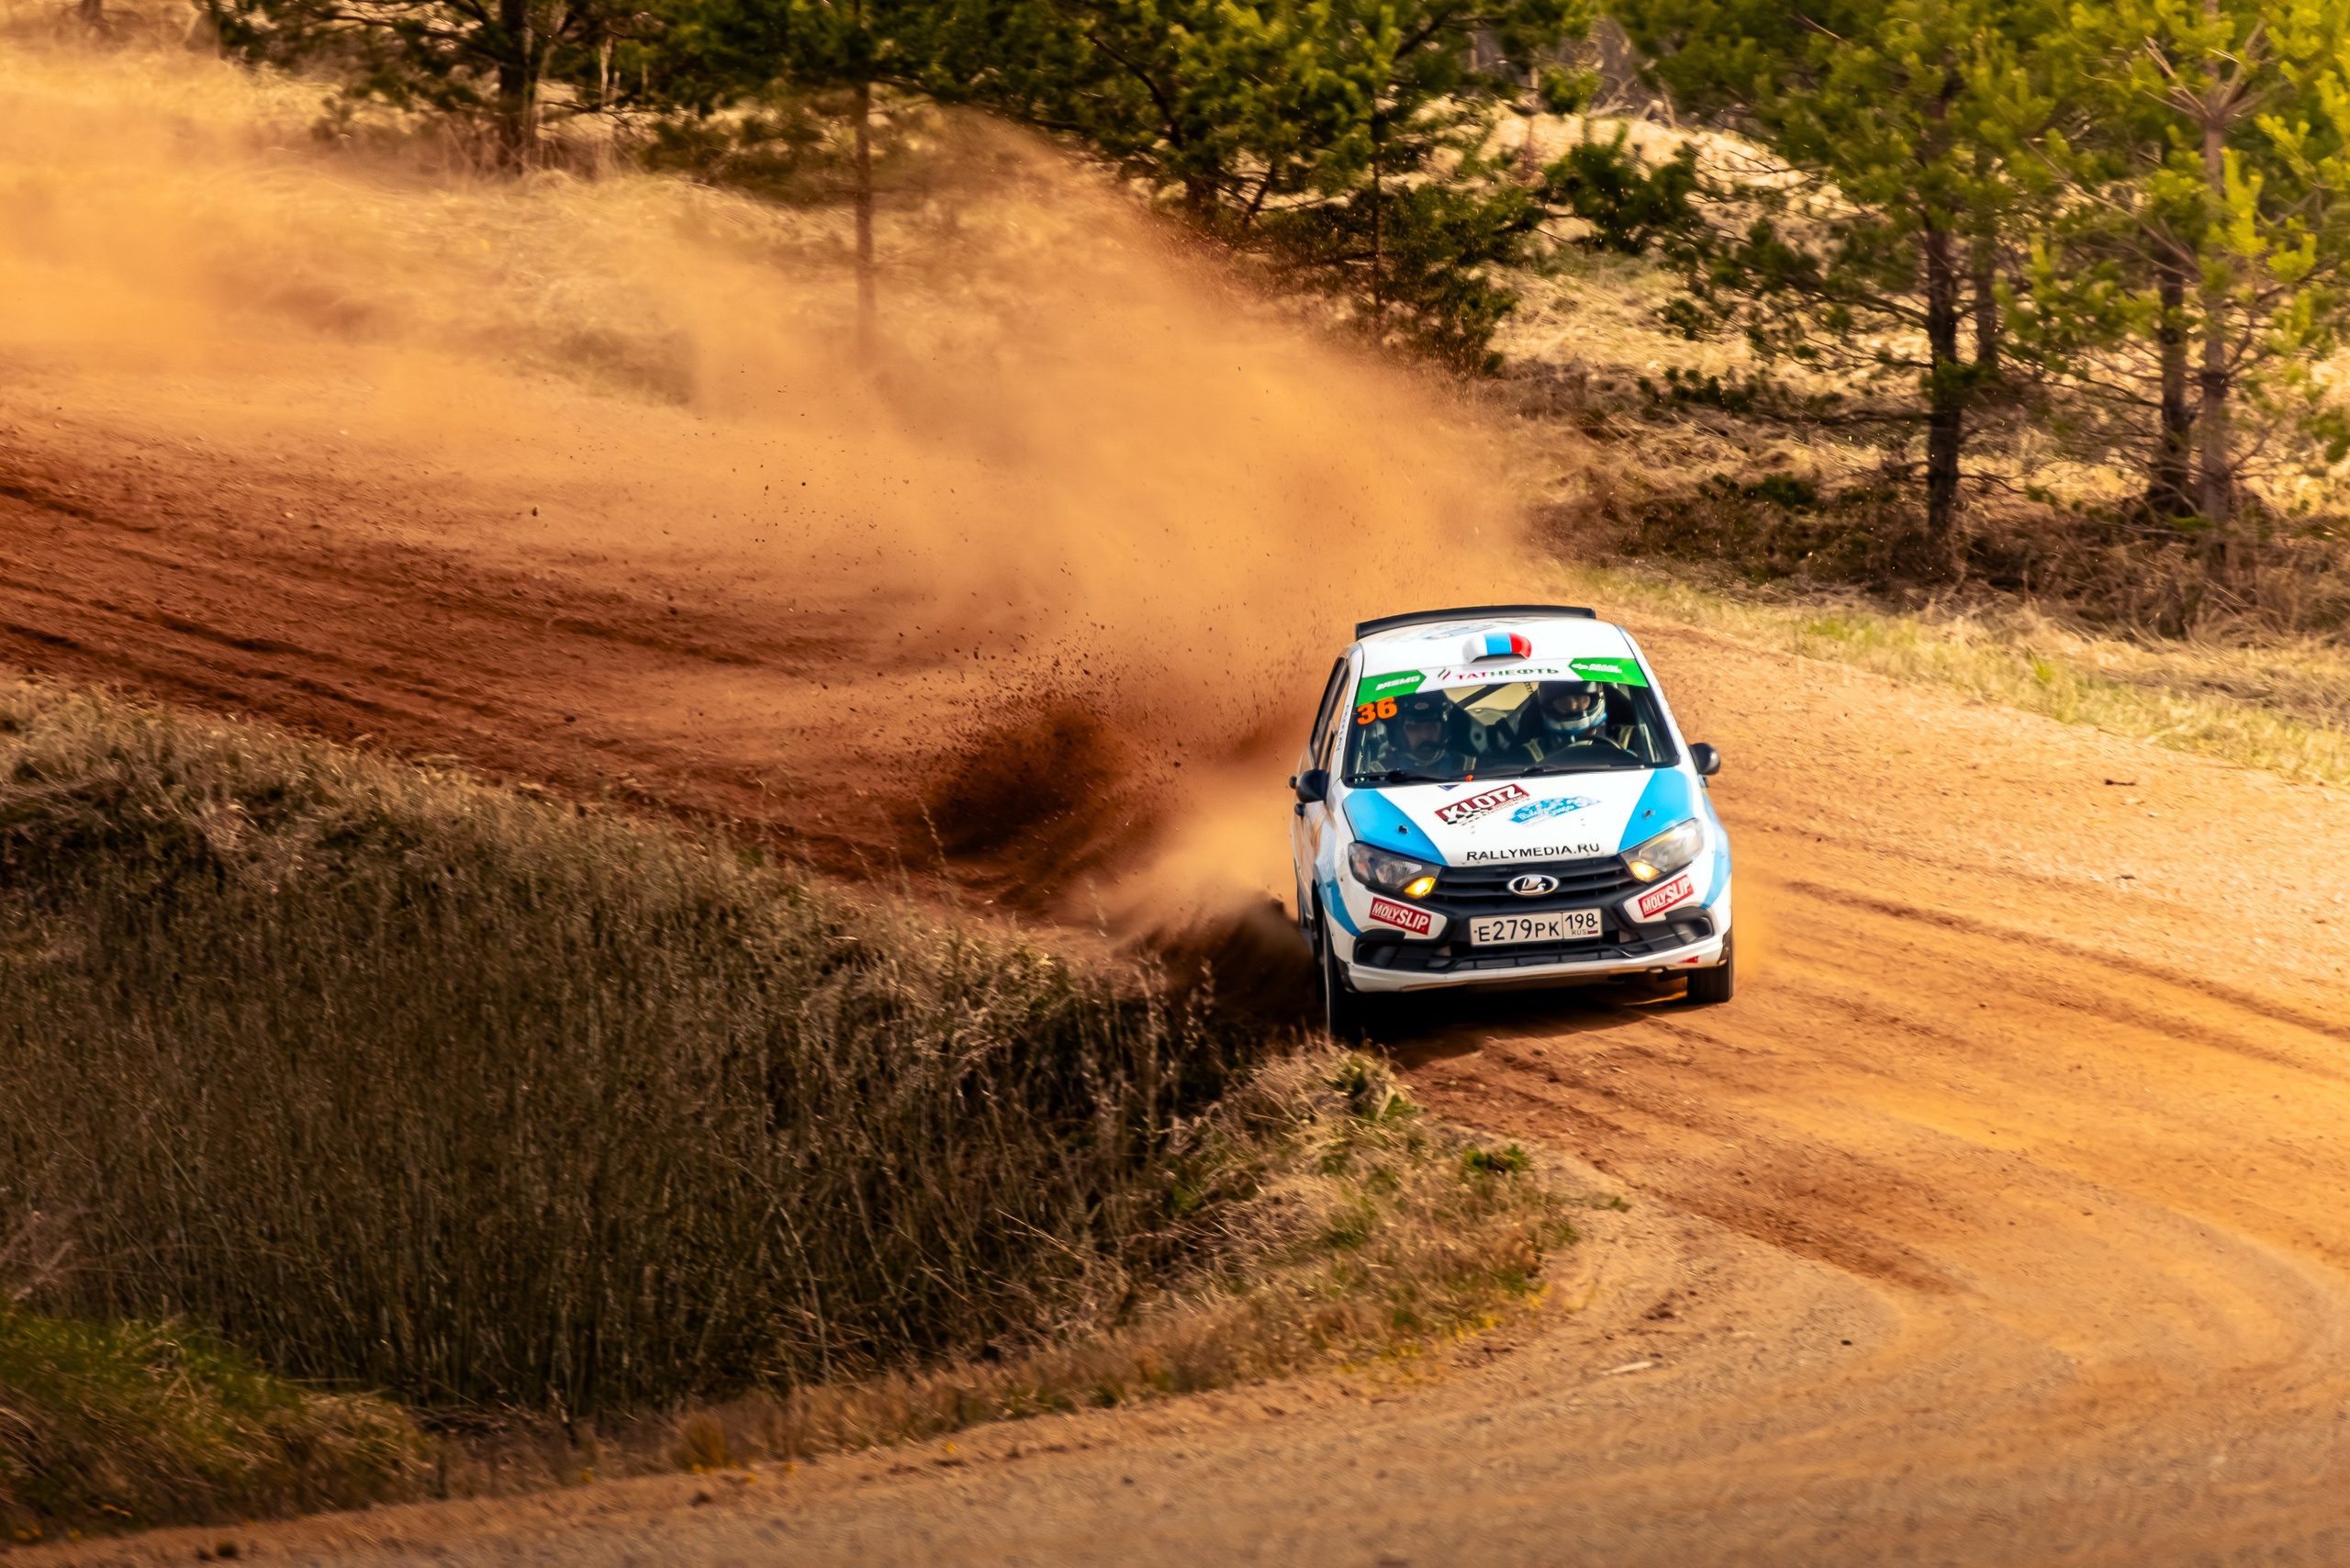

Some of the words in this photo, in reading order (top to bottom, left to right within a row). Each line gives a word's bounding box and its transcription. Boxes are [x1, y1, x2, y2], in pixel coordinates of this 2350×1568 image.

[1457, 668, 1559, 679] ТАТНЕФТЬ
[1357, 696, 1398, 725] 36
[1441, 785, 1523, 823] KLOTZ
[1466, 843, 1600, 861] RALLYMEDIA.RU
[1639, 878, 1690, 913] MOLYSLIP
[1371, 902, 1429, 930] MOLYSLIP
[1564, 913, 1595, 930] 198
